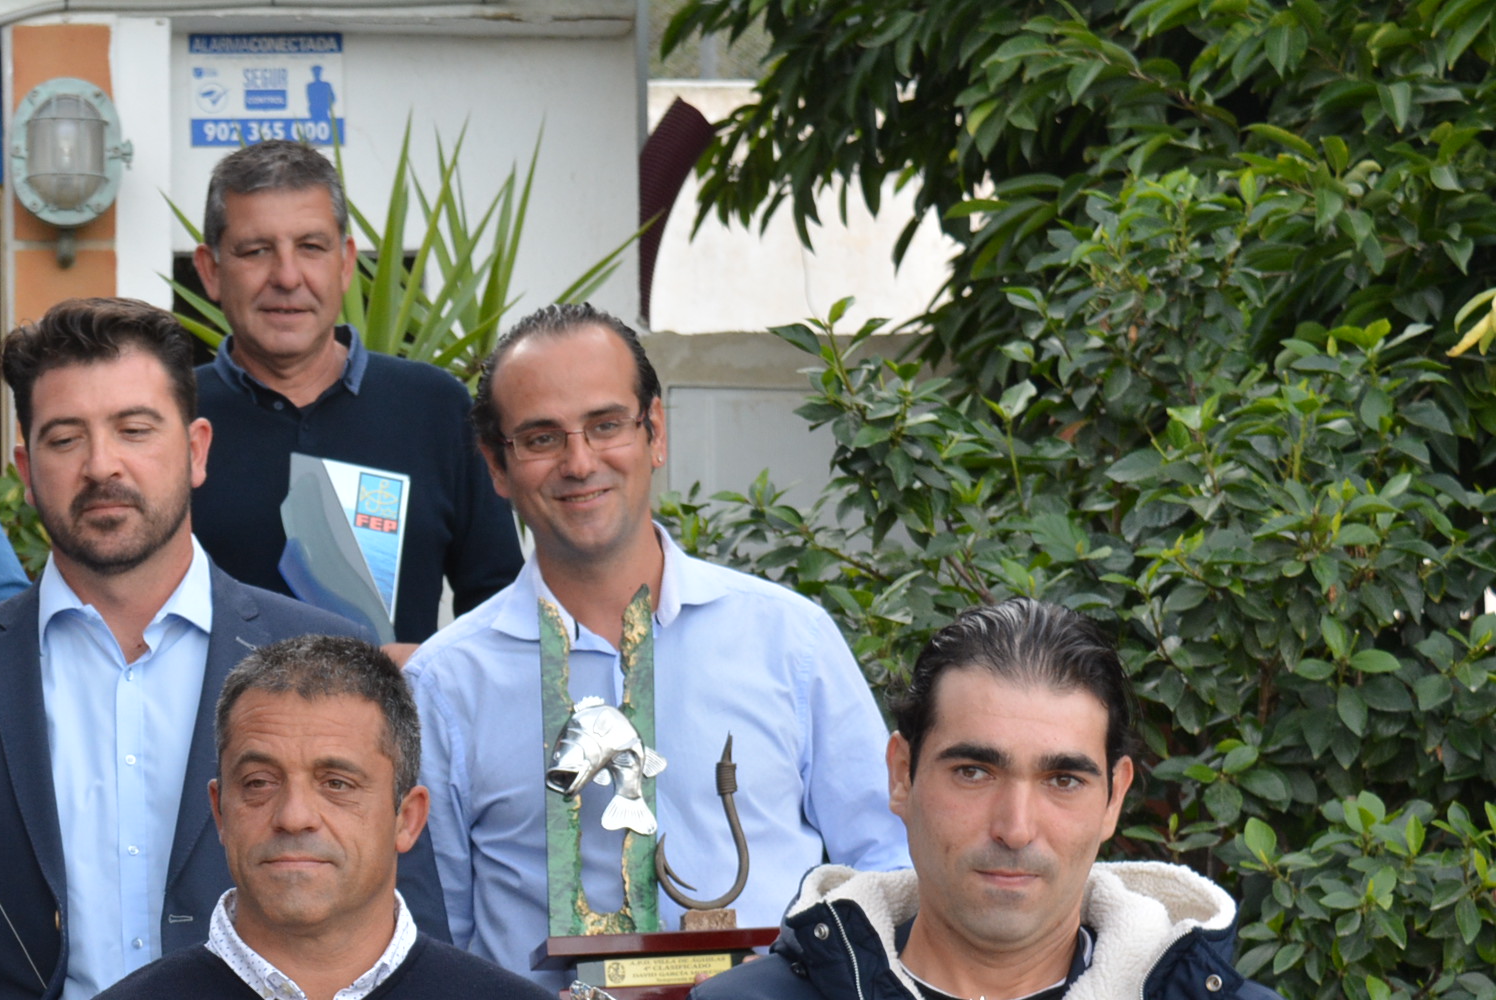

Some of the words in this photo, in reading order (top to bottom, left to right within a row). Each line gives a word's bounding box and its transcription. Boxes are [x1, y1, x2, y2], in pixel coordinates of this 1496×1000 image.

[203, 122, 241, 142] 902
[248, 122, 285, 142] 365
[291, 122, 330, 142] 000
[356, 513, 398, 532] FEP
